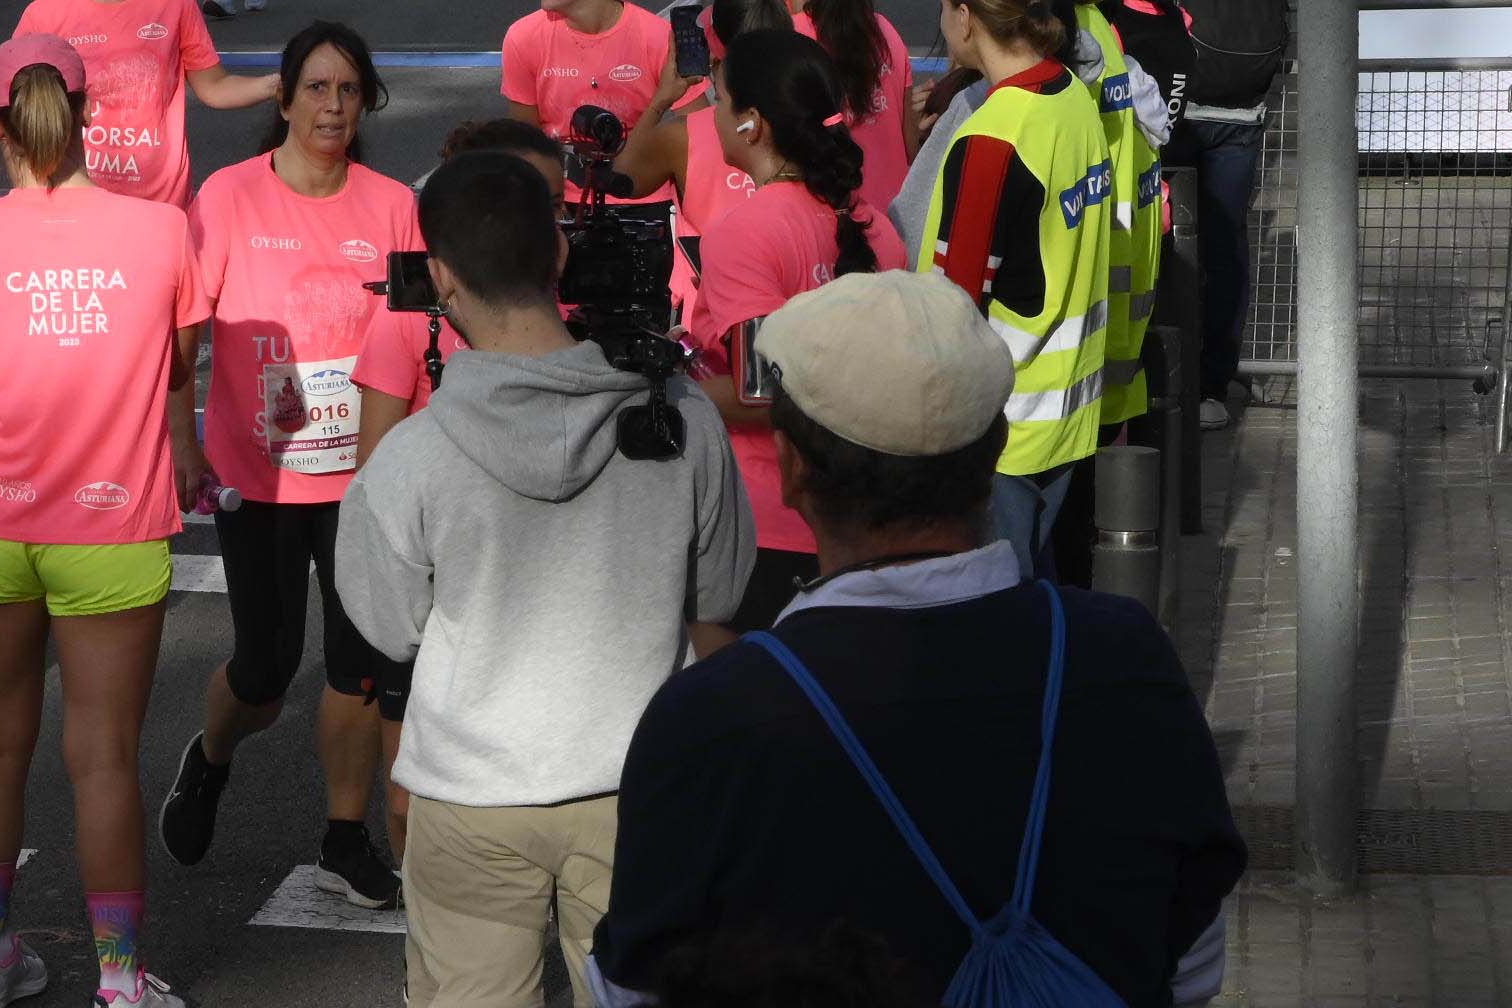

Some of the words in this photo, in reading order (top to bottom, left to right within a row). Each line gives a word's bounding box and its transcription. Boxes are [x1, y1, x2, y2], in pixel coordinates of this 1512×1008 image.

[68, 33, 108, 47] OYSHO
[82, 125, 162, 148] ORSAL
[85, 147, 140, 176] UMA
[726, 172, 756, 191] CA
[251, 235, 302, 251] OYSHO
[5, 268, 128, 294] CARRERA
[31, 291, 63, 314] DE
[72, 290, 104, 312] LA
[28, 312, 109, 336] MUJER
[251, 335, 289, 363] TU
[303, 375, 351, 393] ASTURIANA
[309, 402, 350, 424] 016
[321, 424, 341, 436] 115
[283, 441, 318, 451] CARRERA
[317, 440, 329, 449] DE
[329, 439, 340, 449] LA
[340, 435, 359, 446] MUJE
[279, 455, 320, 468] OYSHO
[77, 488, 125, 504] ASTURIANA
